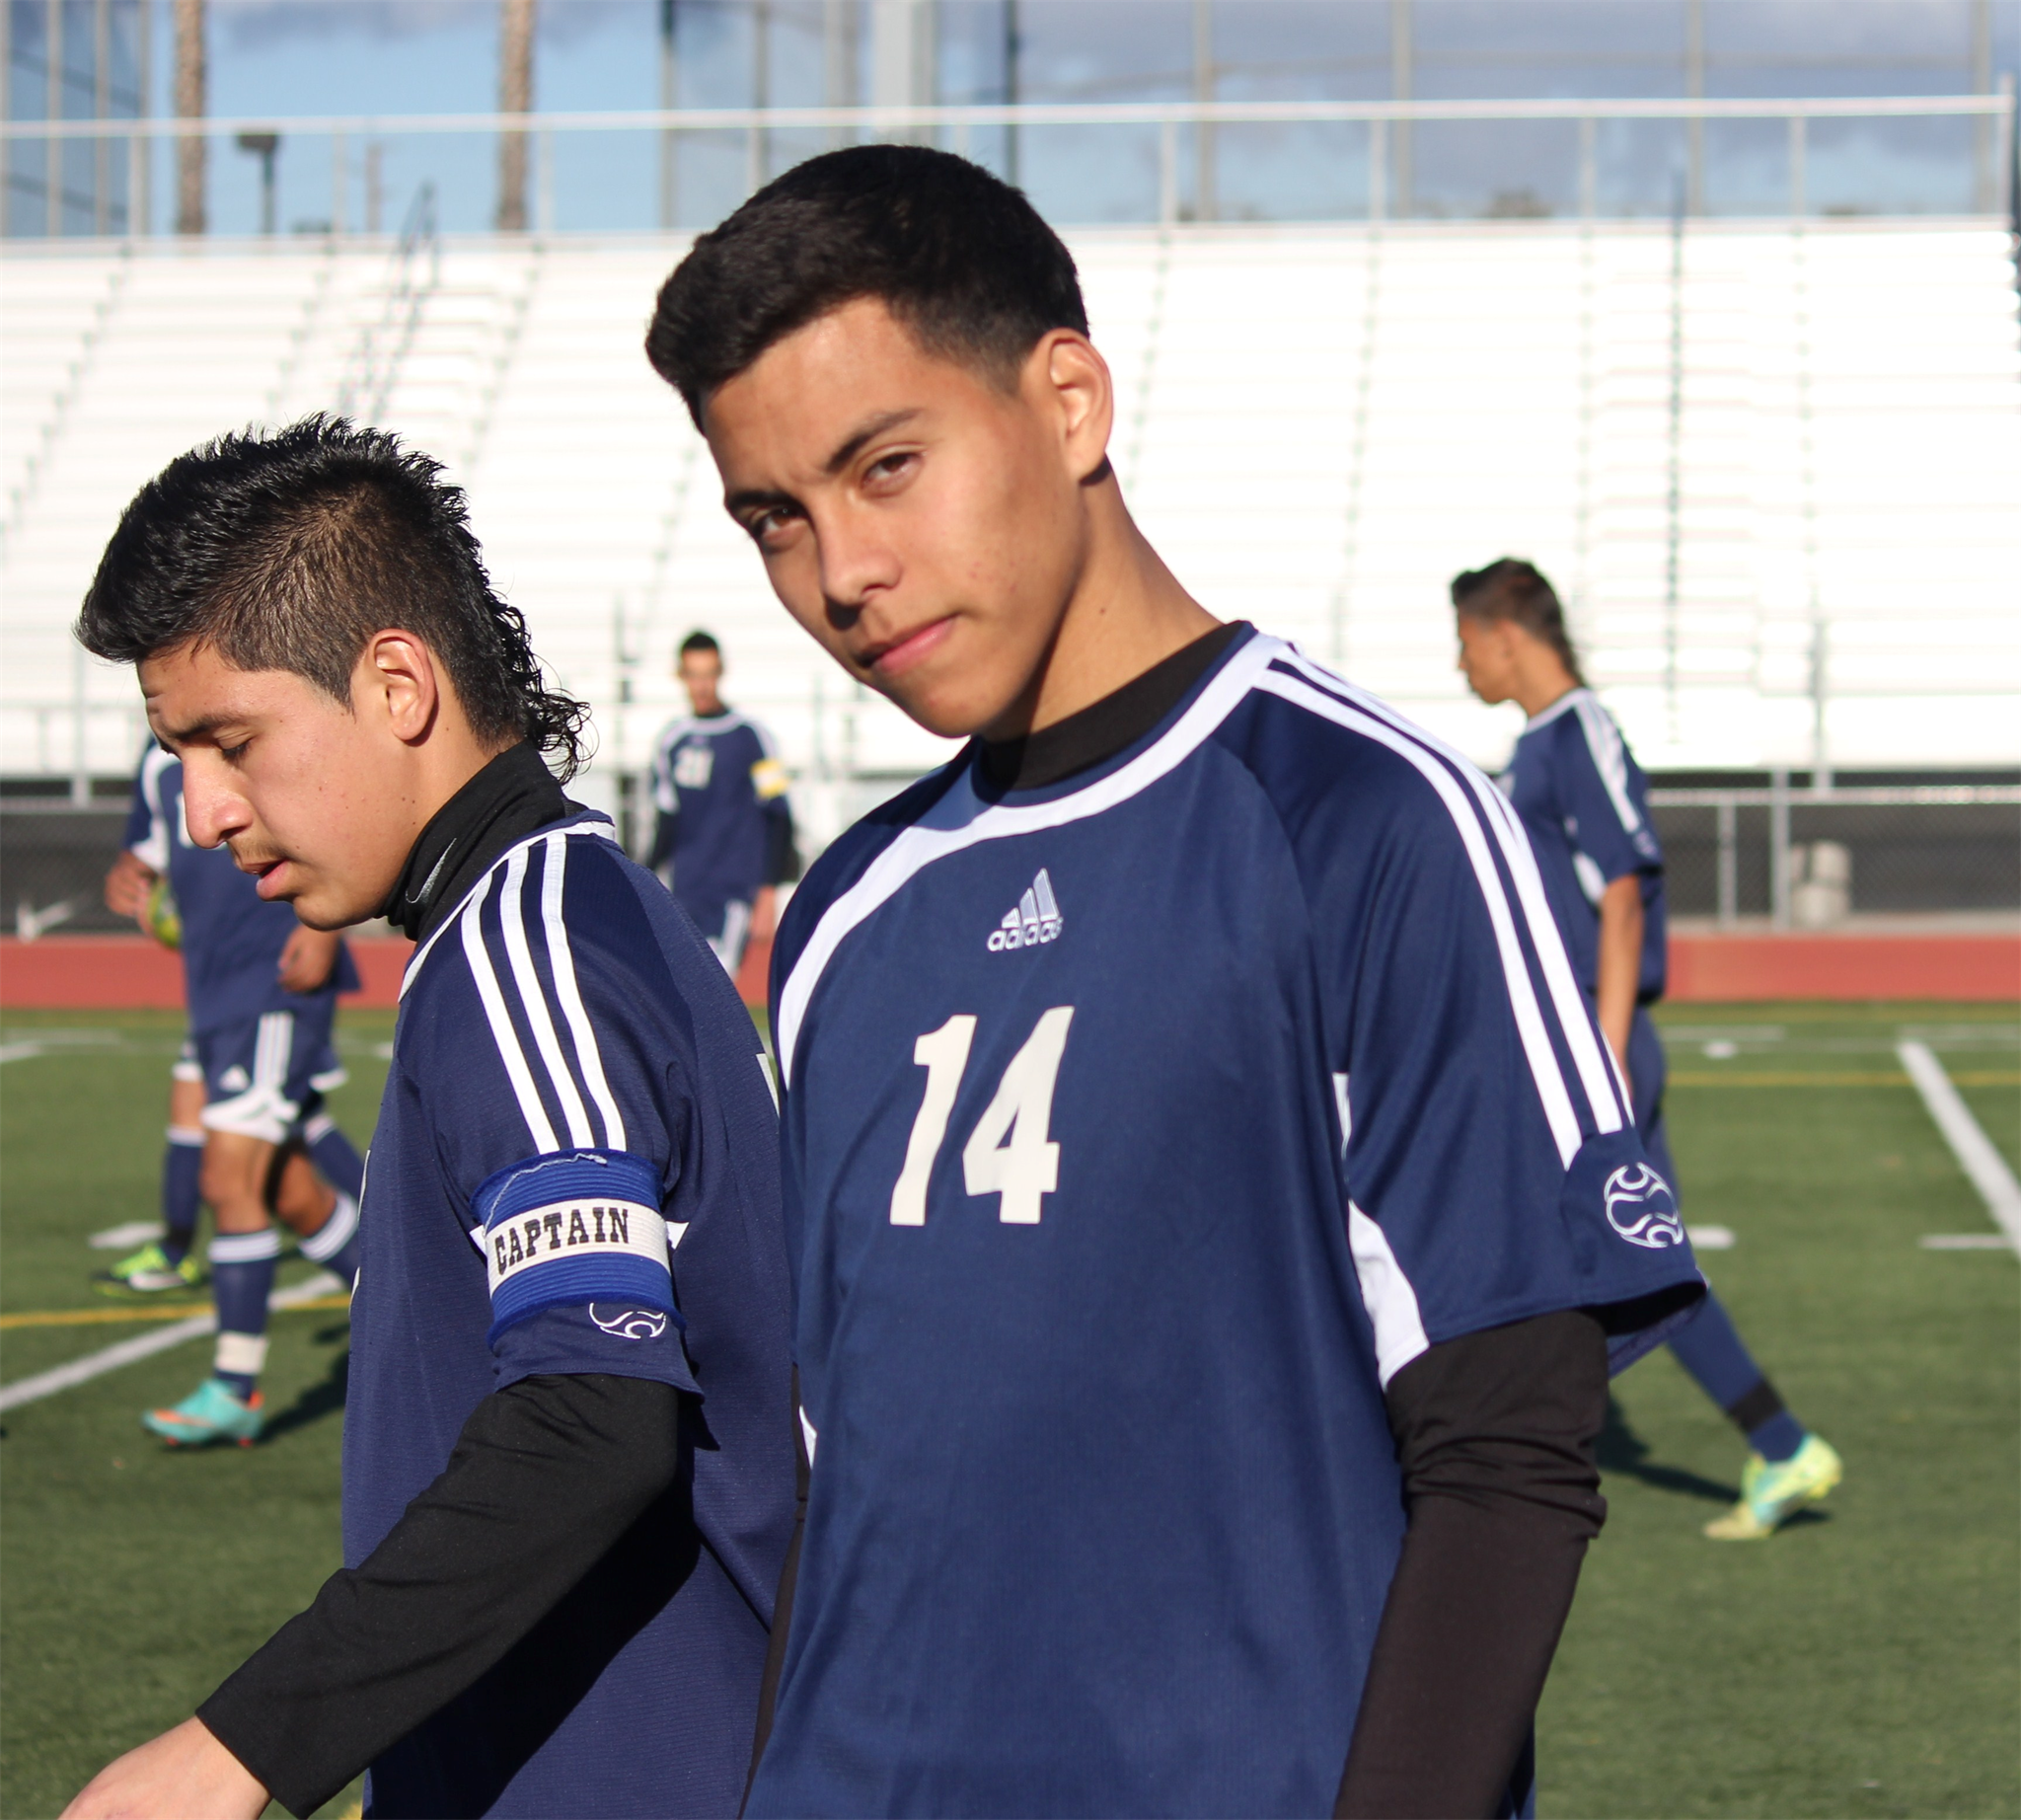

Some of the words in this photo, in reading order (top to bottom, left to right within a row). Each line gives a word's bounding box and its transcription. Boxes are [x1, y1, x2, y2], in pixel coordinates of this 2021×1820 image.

[987, 918, 1064, 951] adidas
[889, 1006, 1075, 1226] 14
[494, 1206, 629, 1275] CAPTAIN
